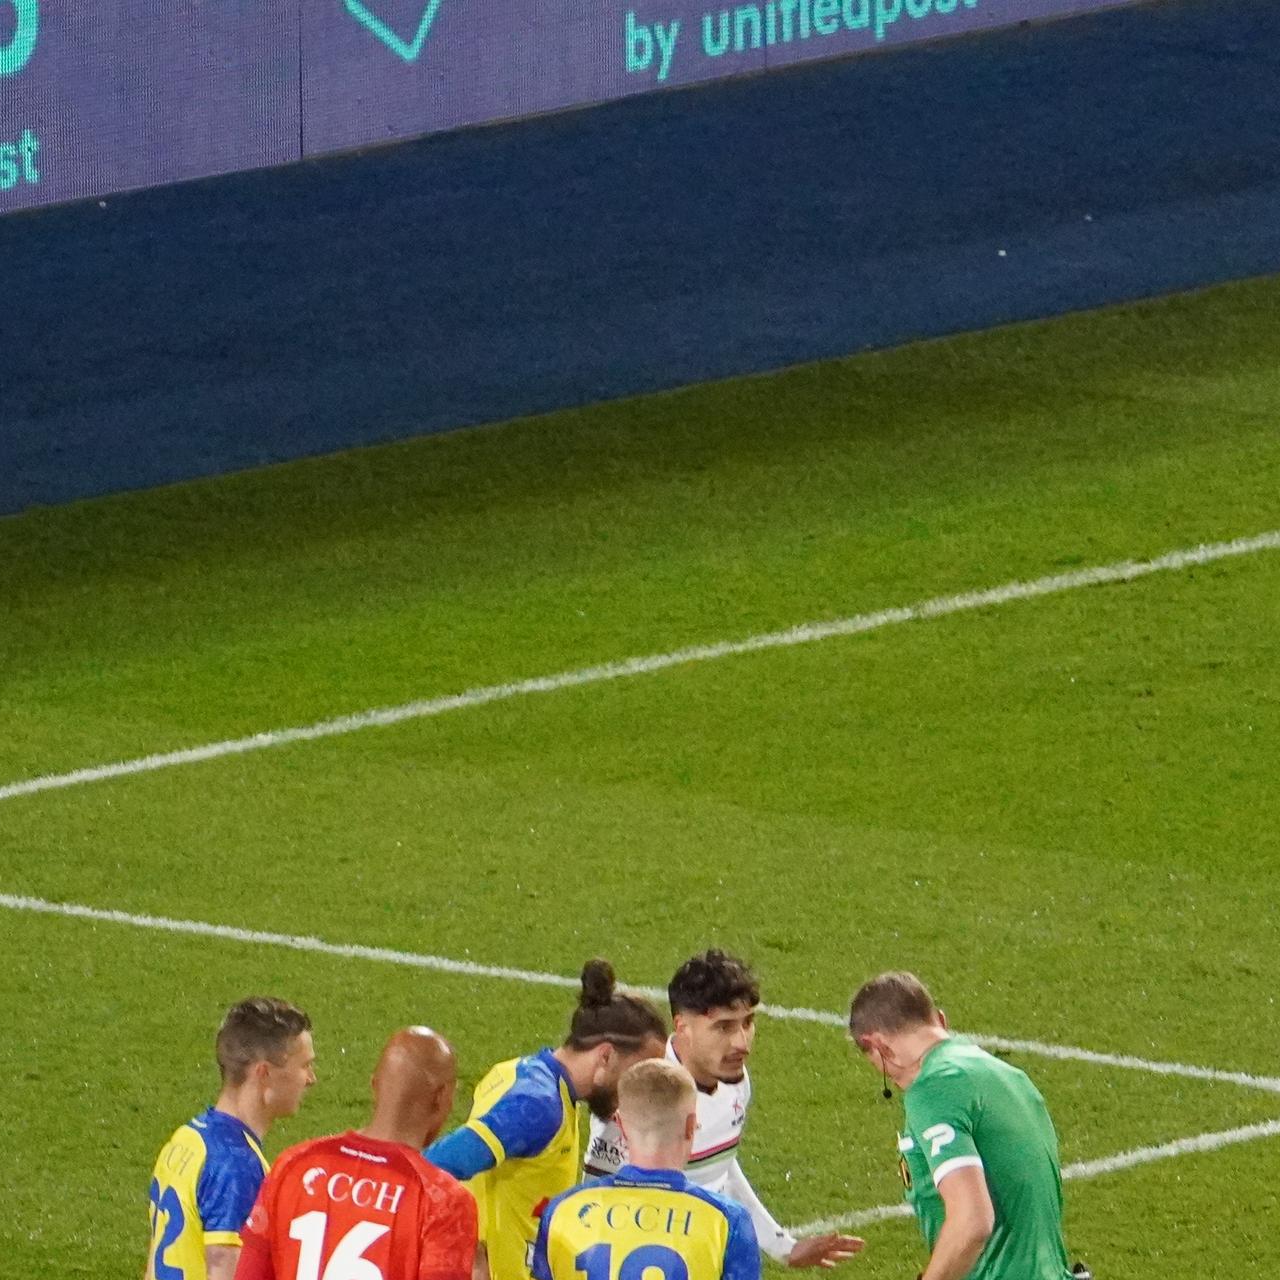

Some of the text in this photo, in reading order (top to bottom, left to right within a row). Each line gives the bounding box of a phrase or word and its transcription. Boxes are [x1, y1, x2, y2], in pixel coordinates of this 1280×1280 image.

[624, 0, 980, 82] by unifiep
[326, 1172, 406, 1214] CCH
[606, 1202, 693, 1237] CCH
